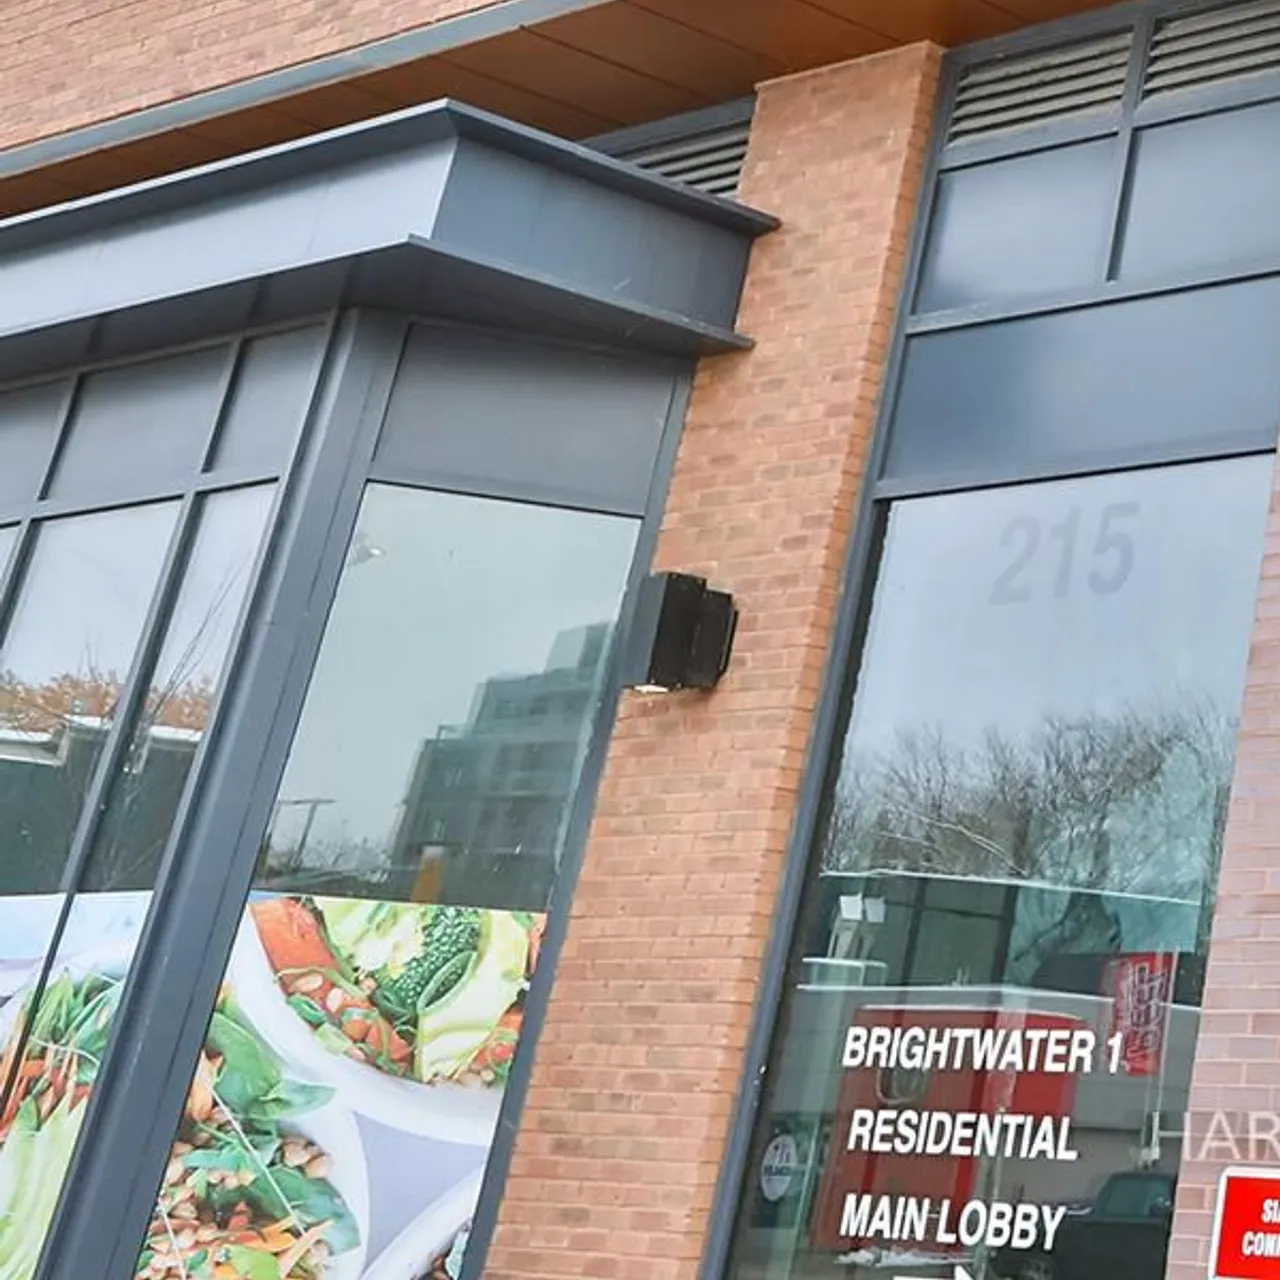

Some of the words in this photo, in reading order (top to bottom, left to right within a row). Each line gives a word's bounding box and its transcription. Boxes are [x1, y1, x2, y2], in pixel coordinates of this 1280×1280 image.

[988, 501, 1140, 606] 215
[842, 1026, 1096, 1073] BRIGHTWATER
[1107, 1031, 1123, 1074] 1
[847, 1109, 1079, 1160] RESIDENTIAL
[839, 1193, 931, 1241] MAIN
[936, 1199, 1067, 1250] LOBBY
